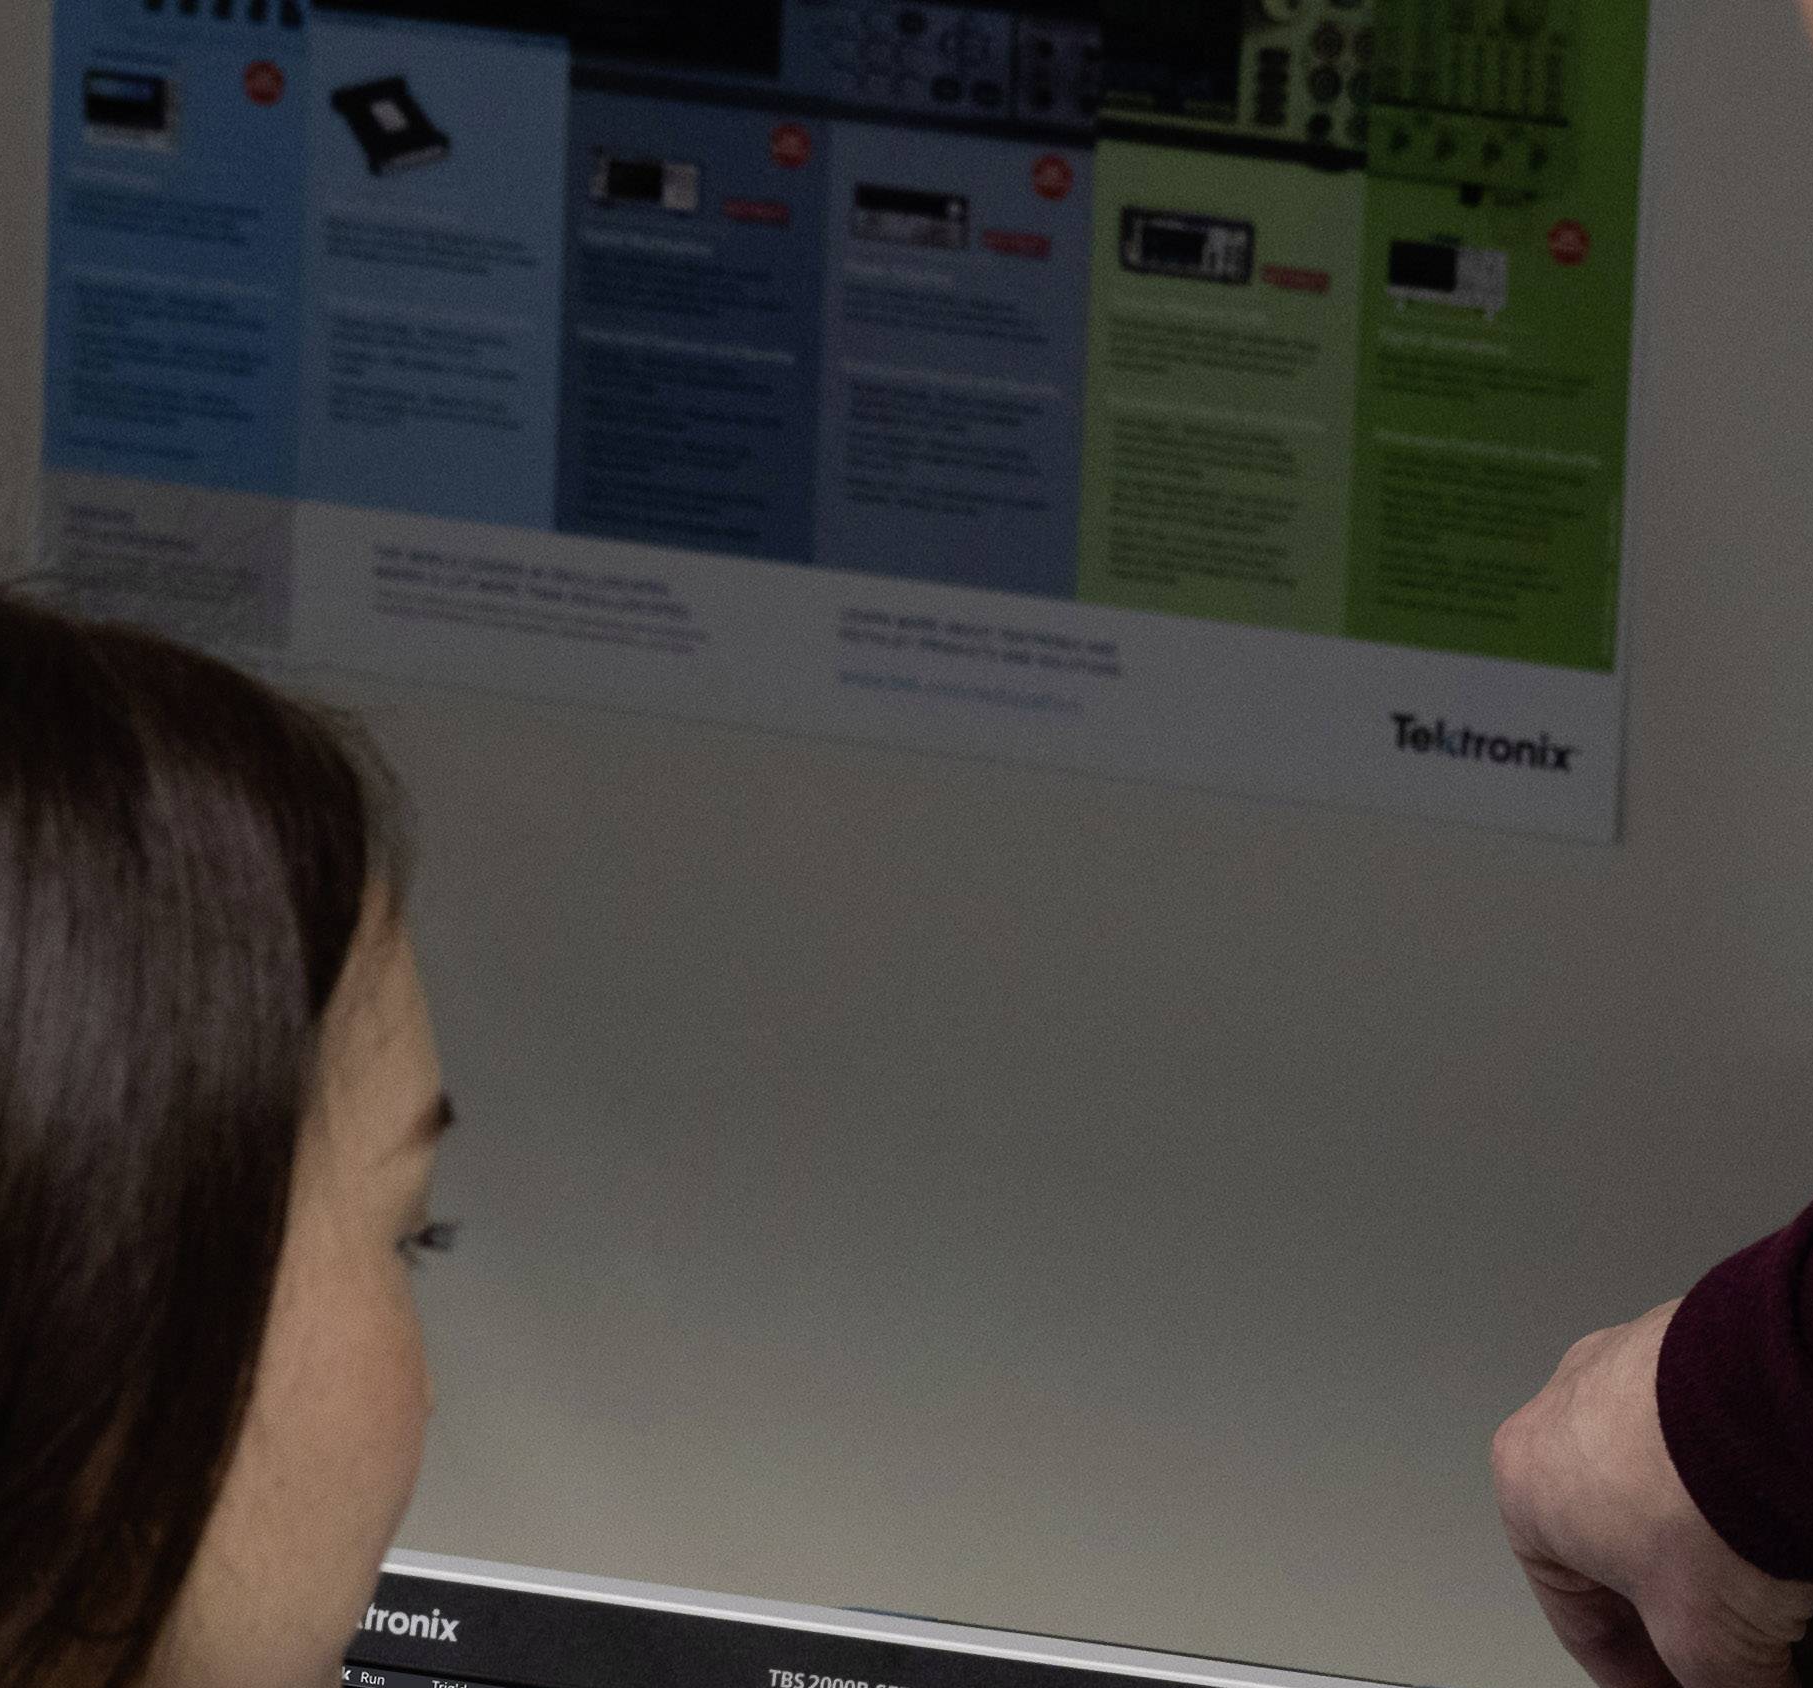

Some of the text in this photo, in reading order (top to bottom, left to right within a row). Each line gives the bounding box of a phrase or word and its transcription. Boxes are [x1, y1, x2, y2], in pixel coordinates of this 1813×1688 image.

[1391, 712, 1573, 772] Tektronix
[357, 1602, 460, 1642] tronix
[360, 1671, 385, 1686] Run
